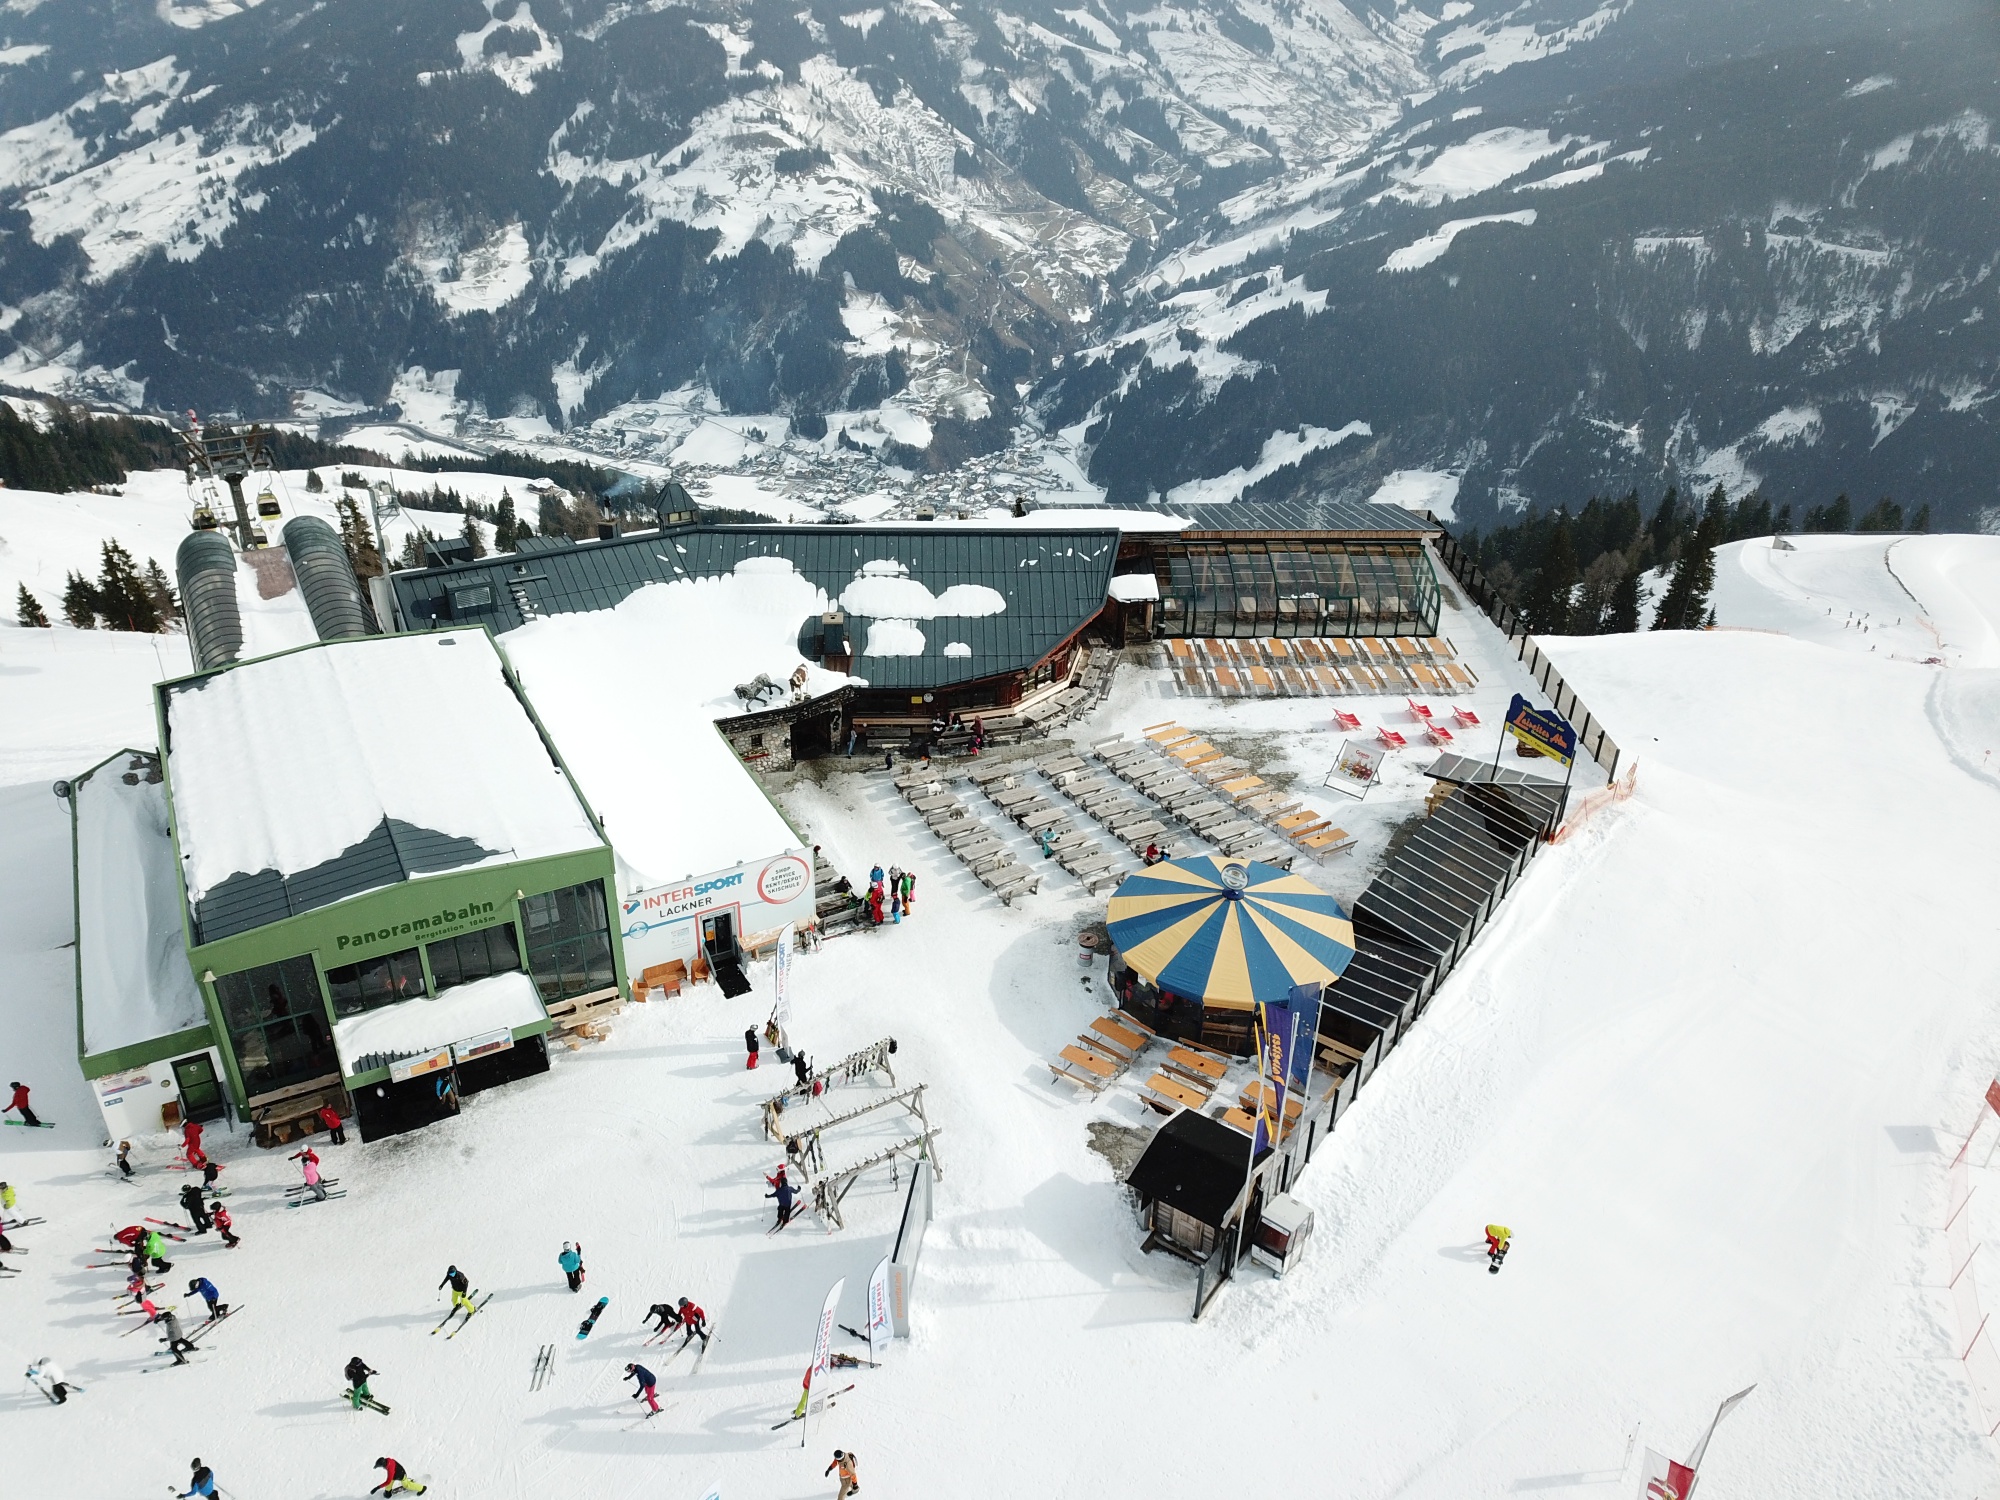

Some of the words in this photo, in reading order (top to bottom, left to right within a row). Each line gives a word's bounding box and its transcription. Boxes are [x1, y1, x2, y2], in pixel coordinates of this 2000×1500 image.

[771, 870, 796, 881] SERVICE
[775, 866, 791, 874] SHOP
[643, 872, 745, 910] INTERSPORT
[765, 875, 802, 889] RENT/DEPOT
[767, 881, 800, 894] SKISCHULE
[659, 896, 713, 918] LACKNER
[336, 901, 494, 950] Panoramabahn
[414, 924, 464, 941] Bergstation
[816, 1312, 827, 1361] SCHISCHULE
[822, 1309, 831, 1356] LACKNER
